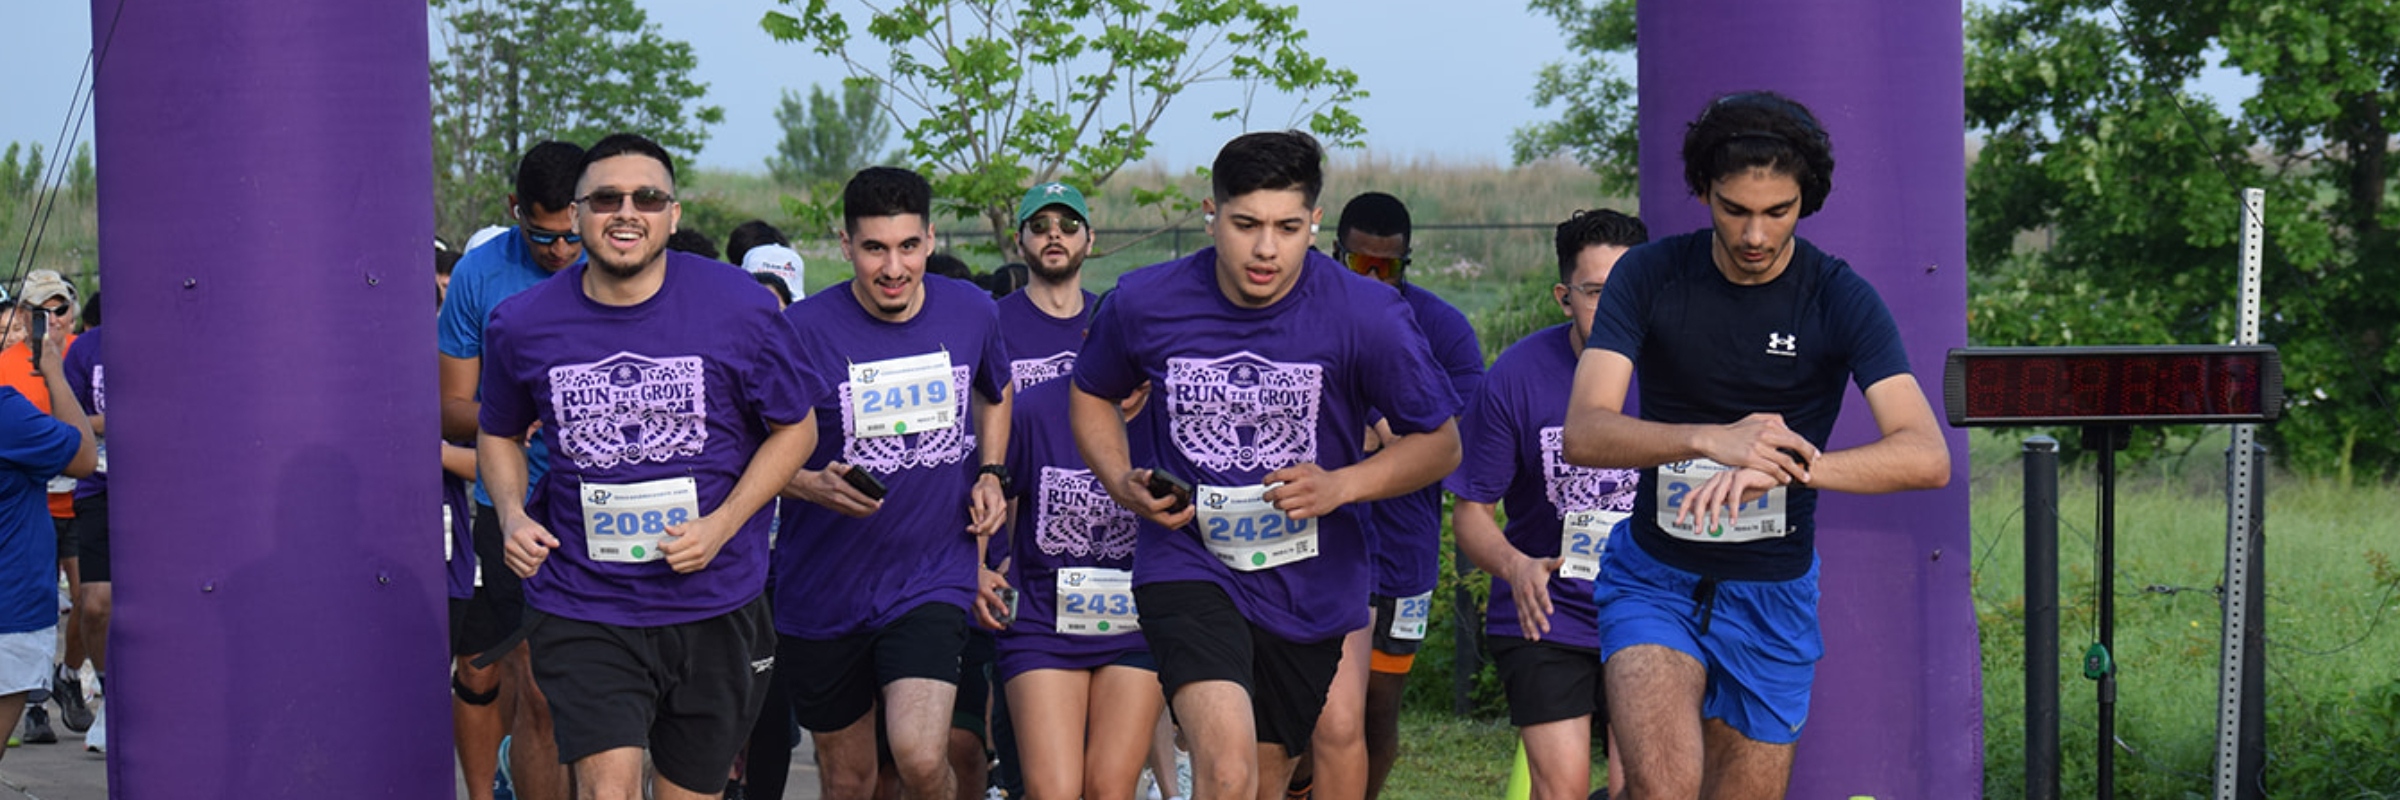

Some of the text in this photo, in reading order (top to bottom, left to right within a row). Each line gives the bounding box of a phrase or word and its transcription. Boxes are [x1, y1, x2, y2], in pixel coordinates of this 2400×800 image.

[562, 382, 695, 407] RUN THE GROVE
[862, 380, 948, 413] 2419
[1175, 383, 1312, 407] RUN THE GROVE
[614, 400, 639, 415] 5K
[1230, 401, 1256, 415] 5K
[1047, 488, 1089, 507] RUN
[592, 508, 689, 536] 2088
[1208, 513, 1308, 542] 2420
